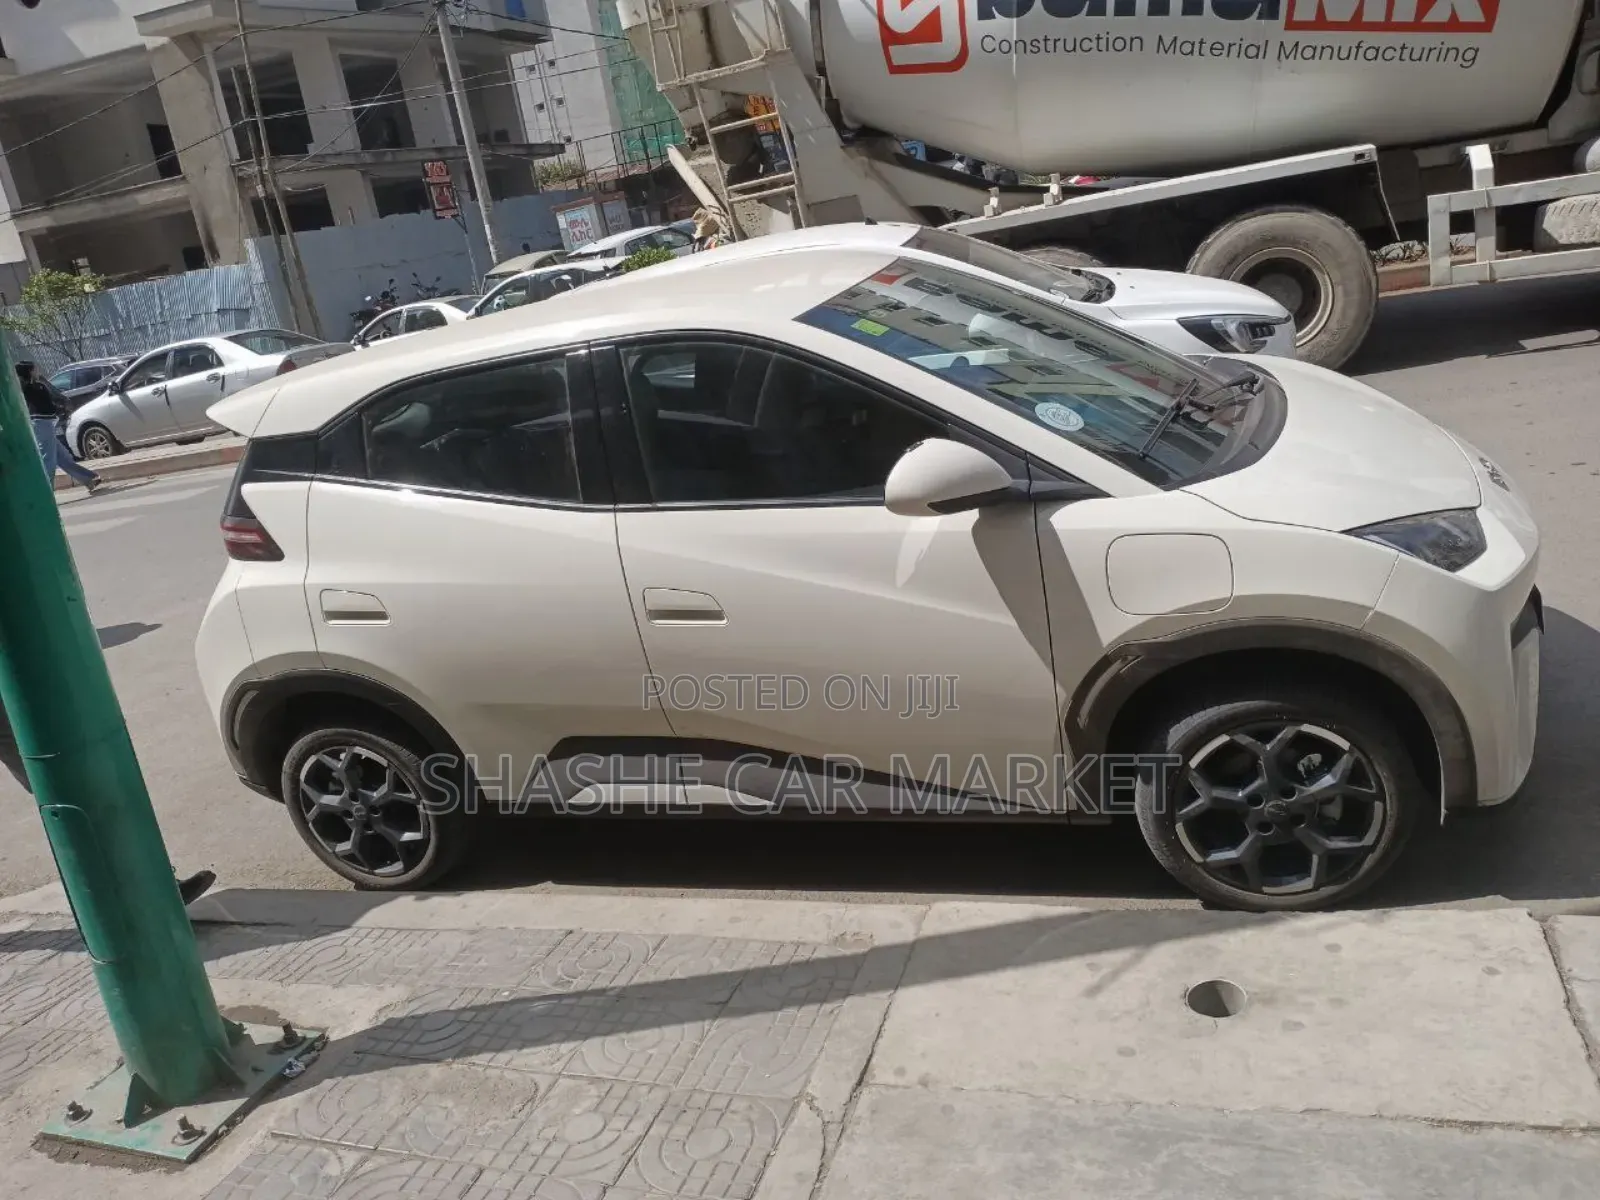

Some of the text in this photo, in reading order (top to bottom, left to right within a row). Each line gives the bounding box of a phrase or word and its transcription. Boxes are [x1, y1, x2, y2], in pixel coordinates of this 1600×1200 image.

[980, 31, 1480, 69] Construction Material Manufacturing
